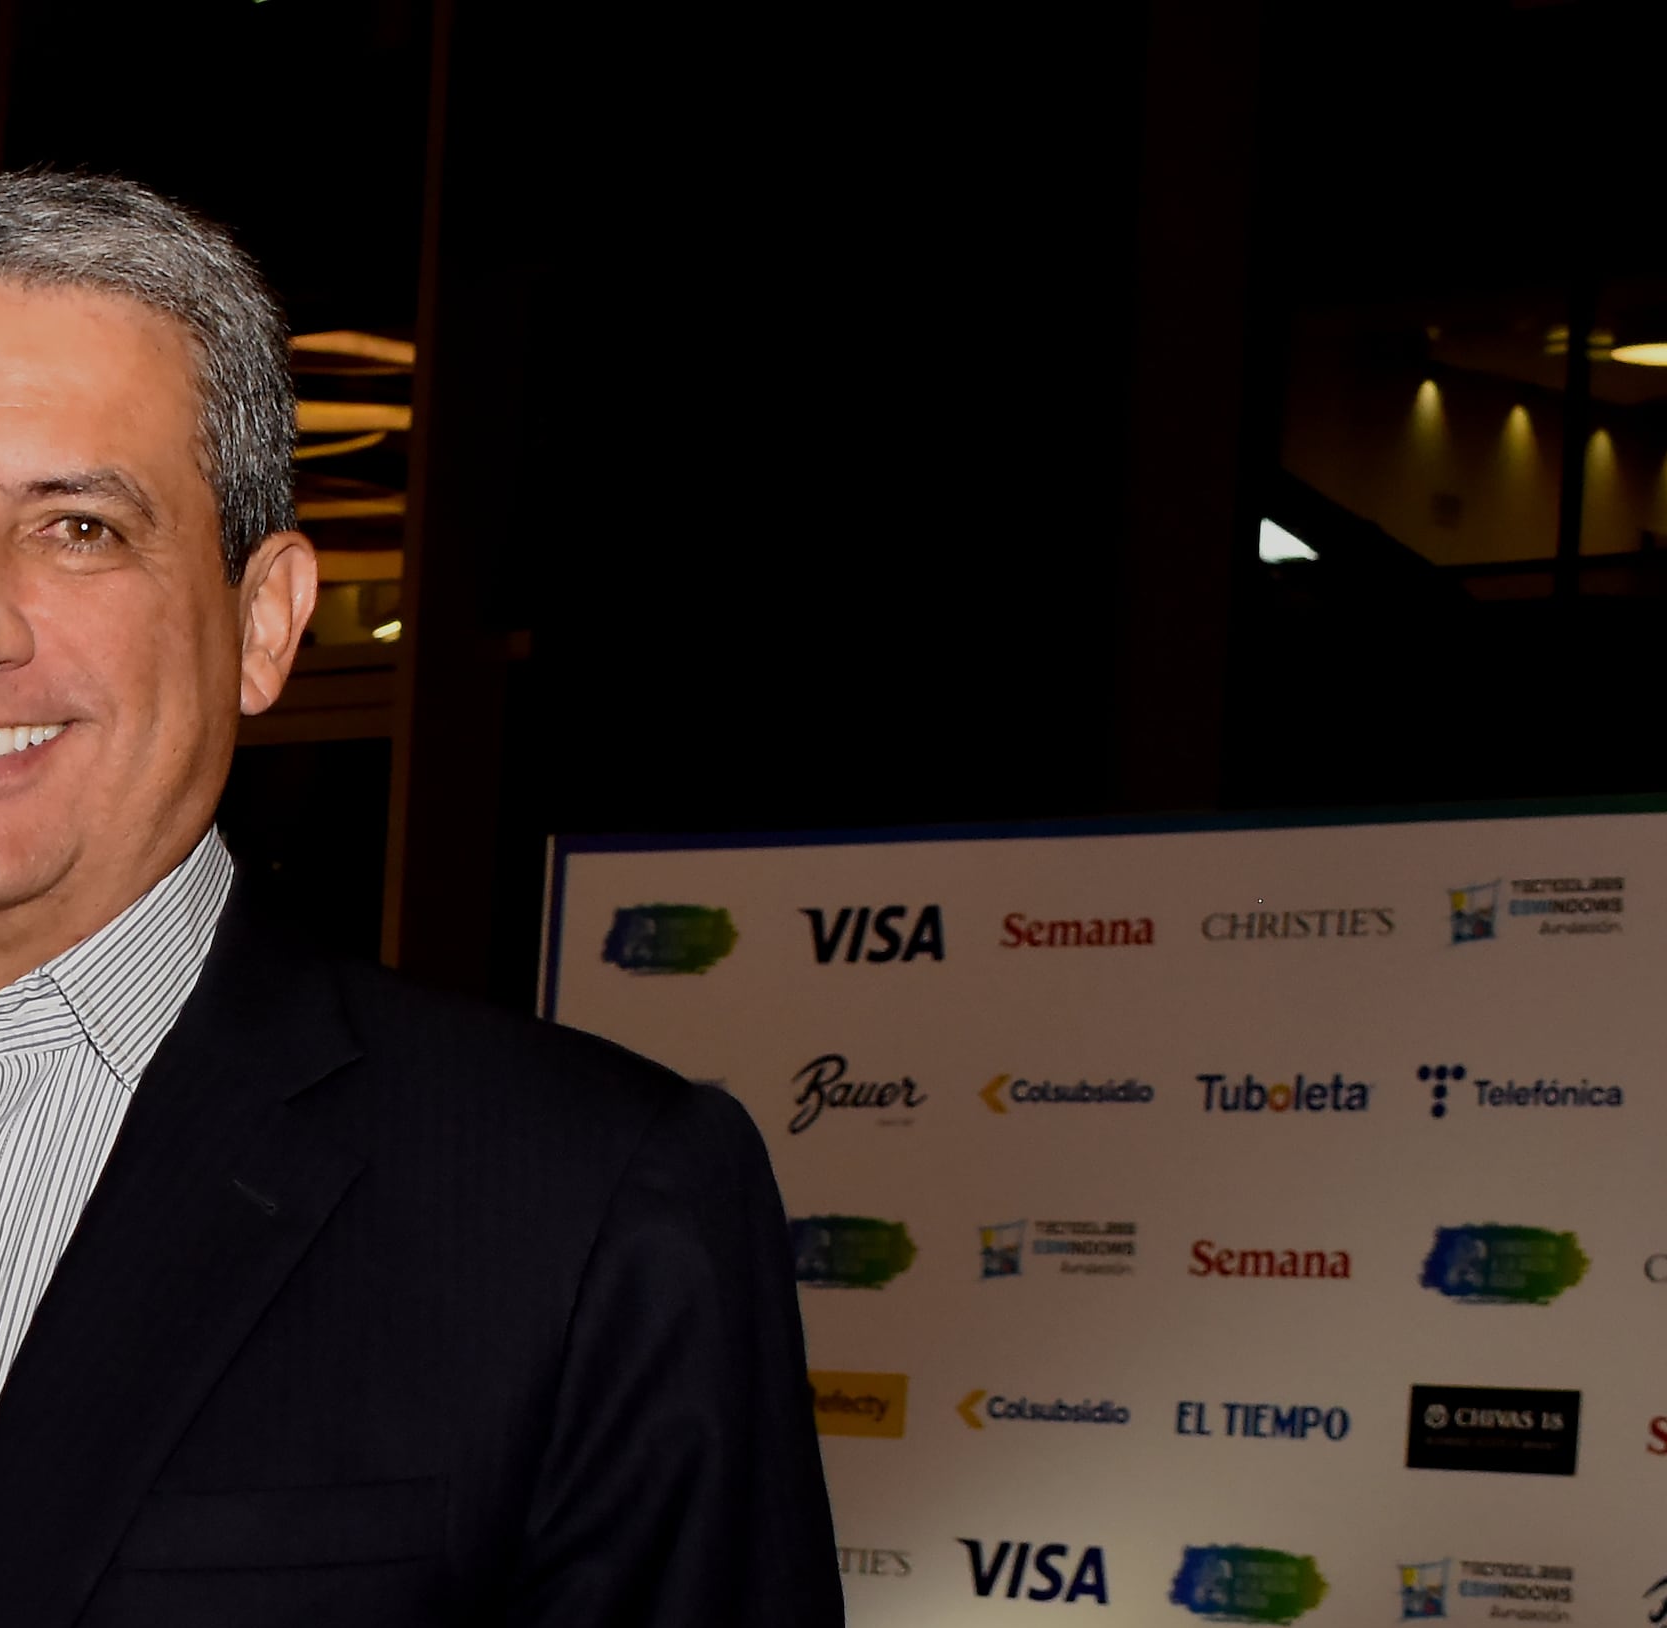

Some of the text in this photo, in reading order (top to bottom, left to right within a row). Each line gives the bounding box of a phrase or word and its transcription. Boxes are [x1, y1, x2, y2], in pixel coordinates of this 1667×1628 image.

[799, 905, 946, 964] VISA
[1000, 912, 1155, 949] Semana
[1201, 908, 1396, 941] CHRISTIE'S
[788, 1054, 928, 1136] Bauer
[1010, 1079, 1156, 1105] Colsubsidio
[1196, 1074, 1369, 1113] Tuboleta
[1473, 1079, 1624, 1108] Telefónica
[1189, 1240, 1351, 1280] Semana
[987, 1396, 1131, 1425] Colsubsidio
[1176, 1401, 1351, 1441] EL TIEMPO
[958, 1537, 1110, 1605] VISA
